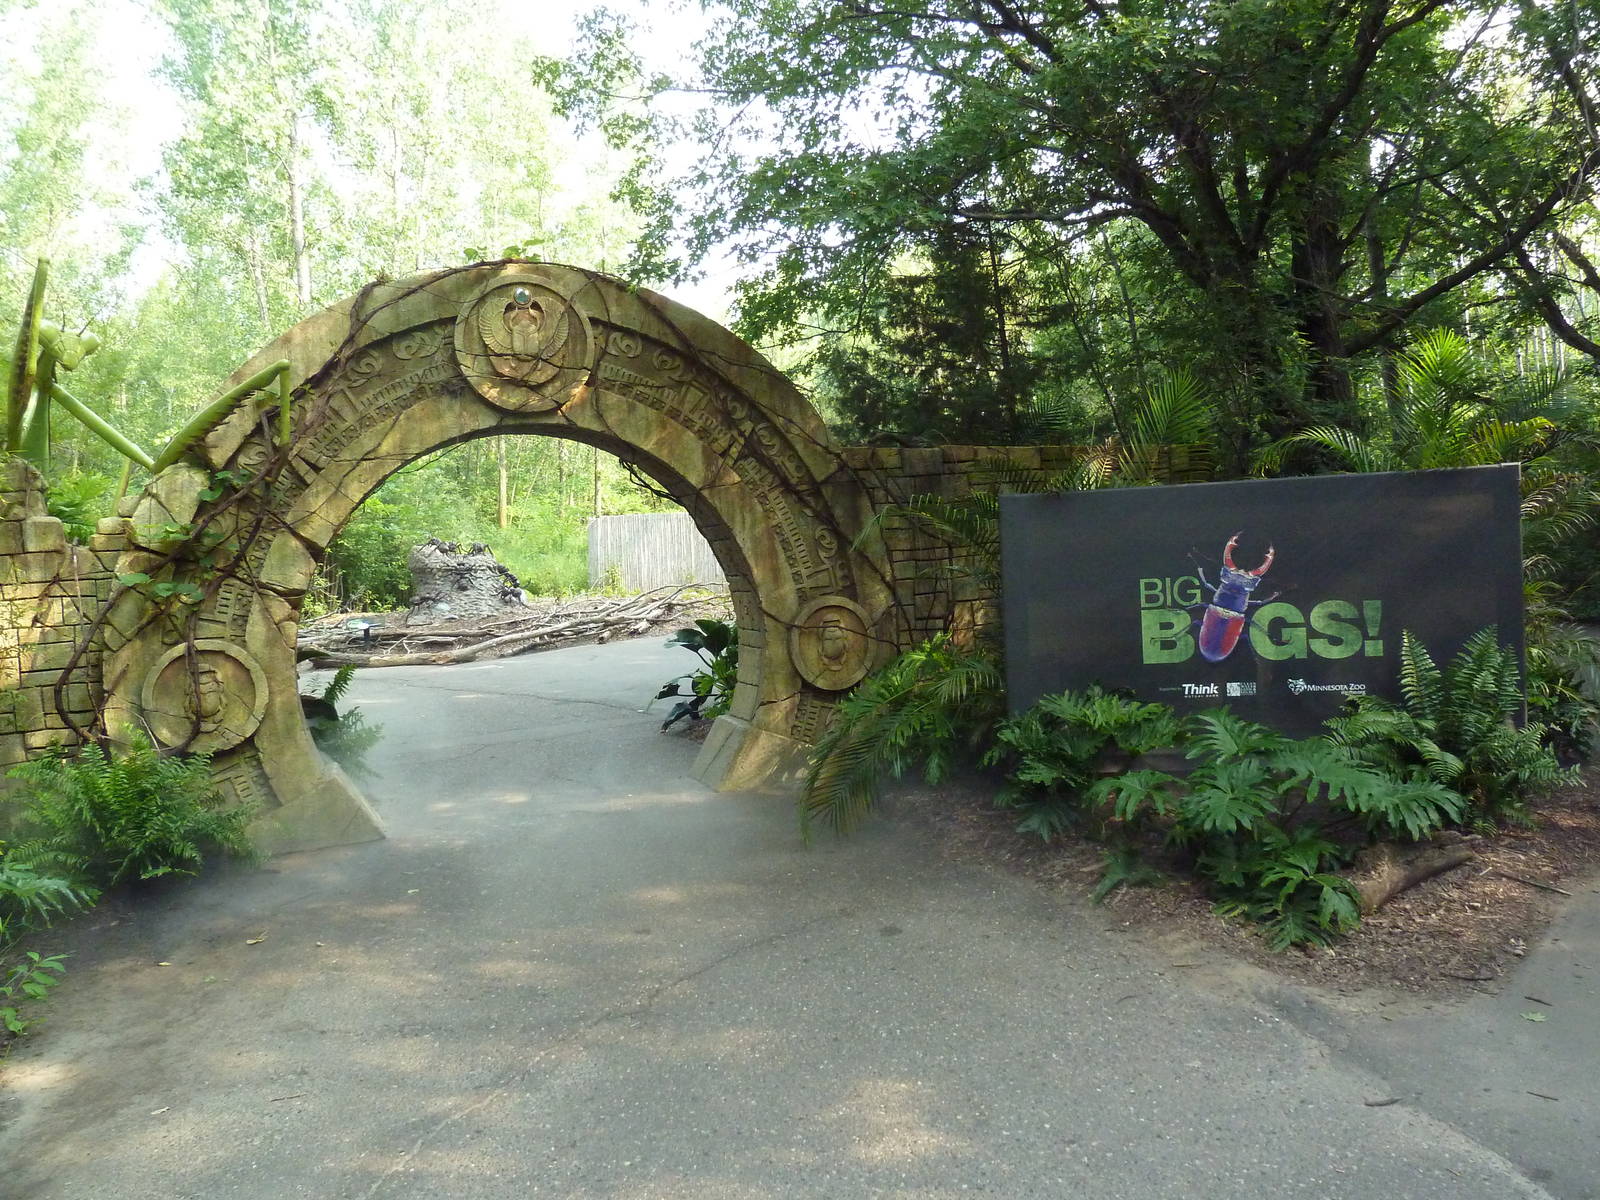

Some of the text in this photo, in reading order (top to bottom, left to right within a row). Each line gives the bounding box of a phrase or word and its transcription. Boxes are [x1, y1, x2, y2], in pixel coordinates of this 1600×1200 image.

[1139, 576, 1202, 608] BIG
[1182, 683, 1219, 695] Think
[1307, 683, 1366, 692] MINNESOTA ZOO
